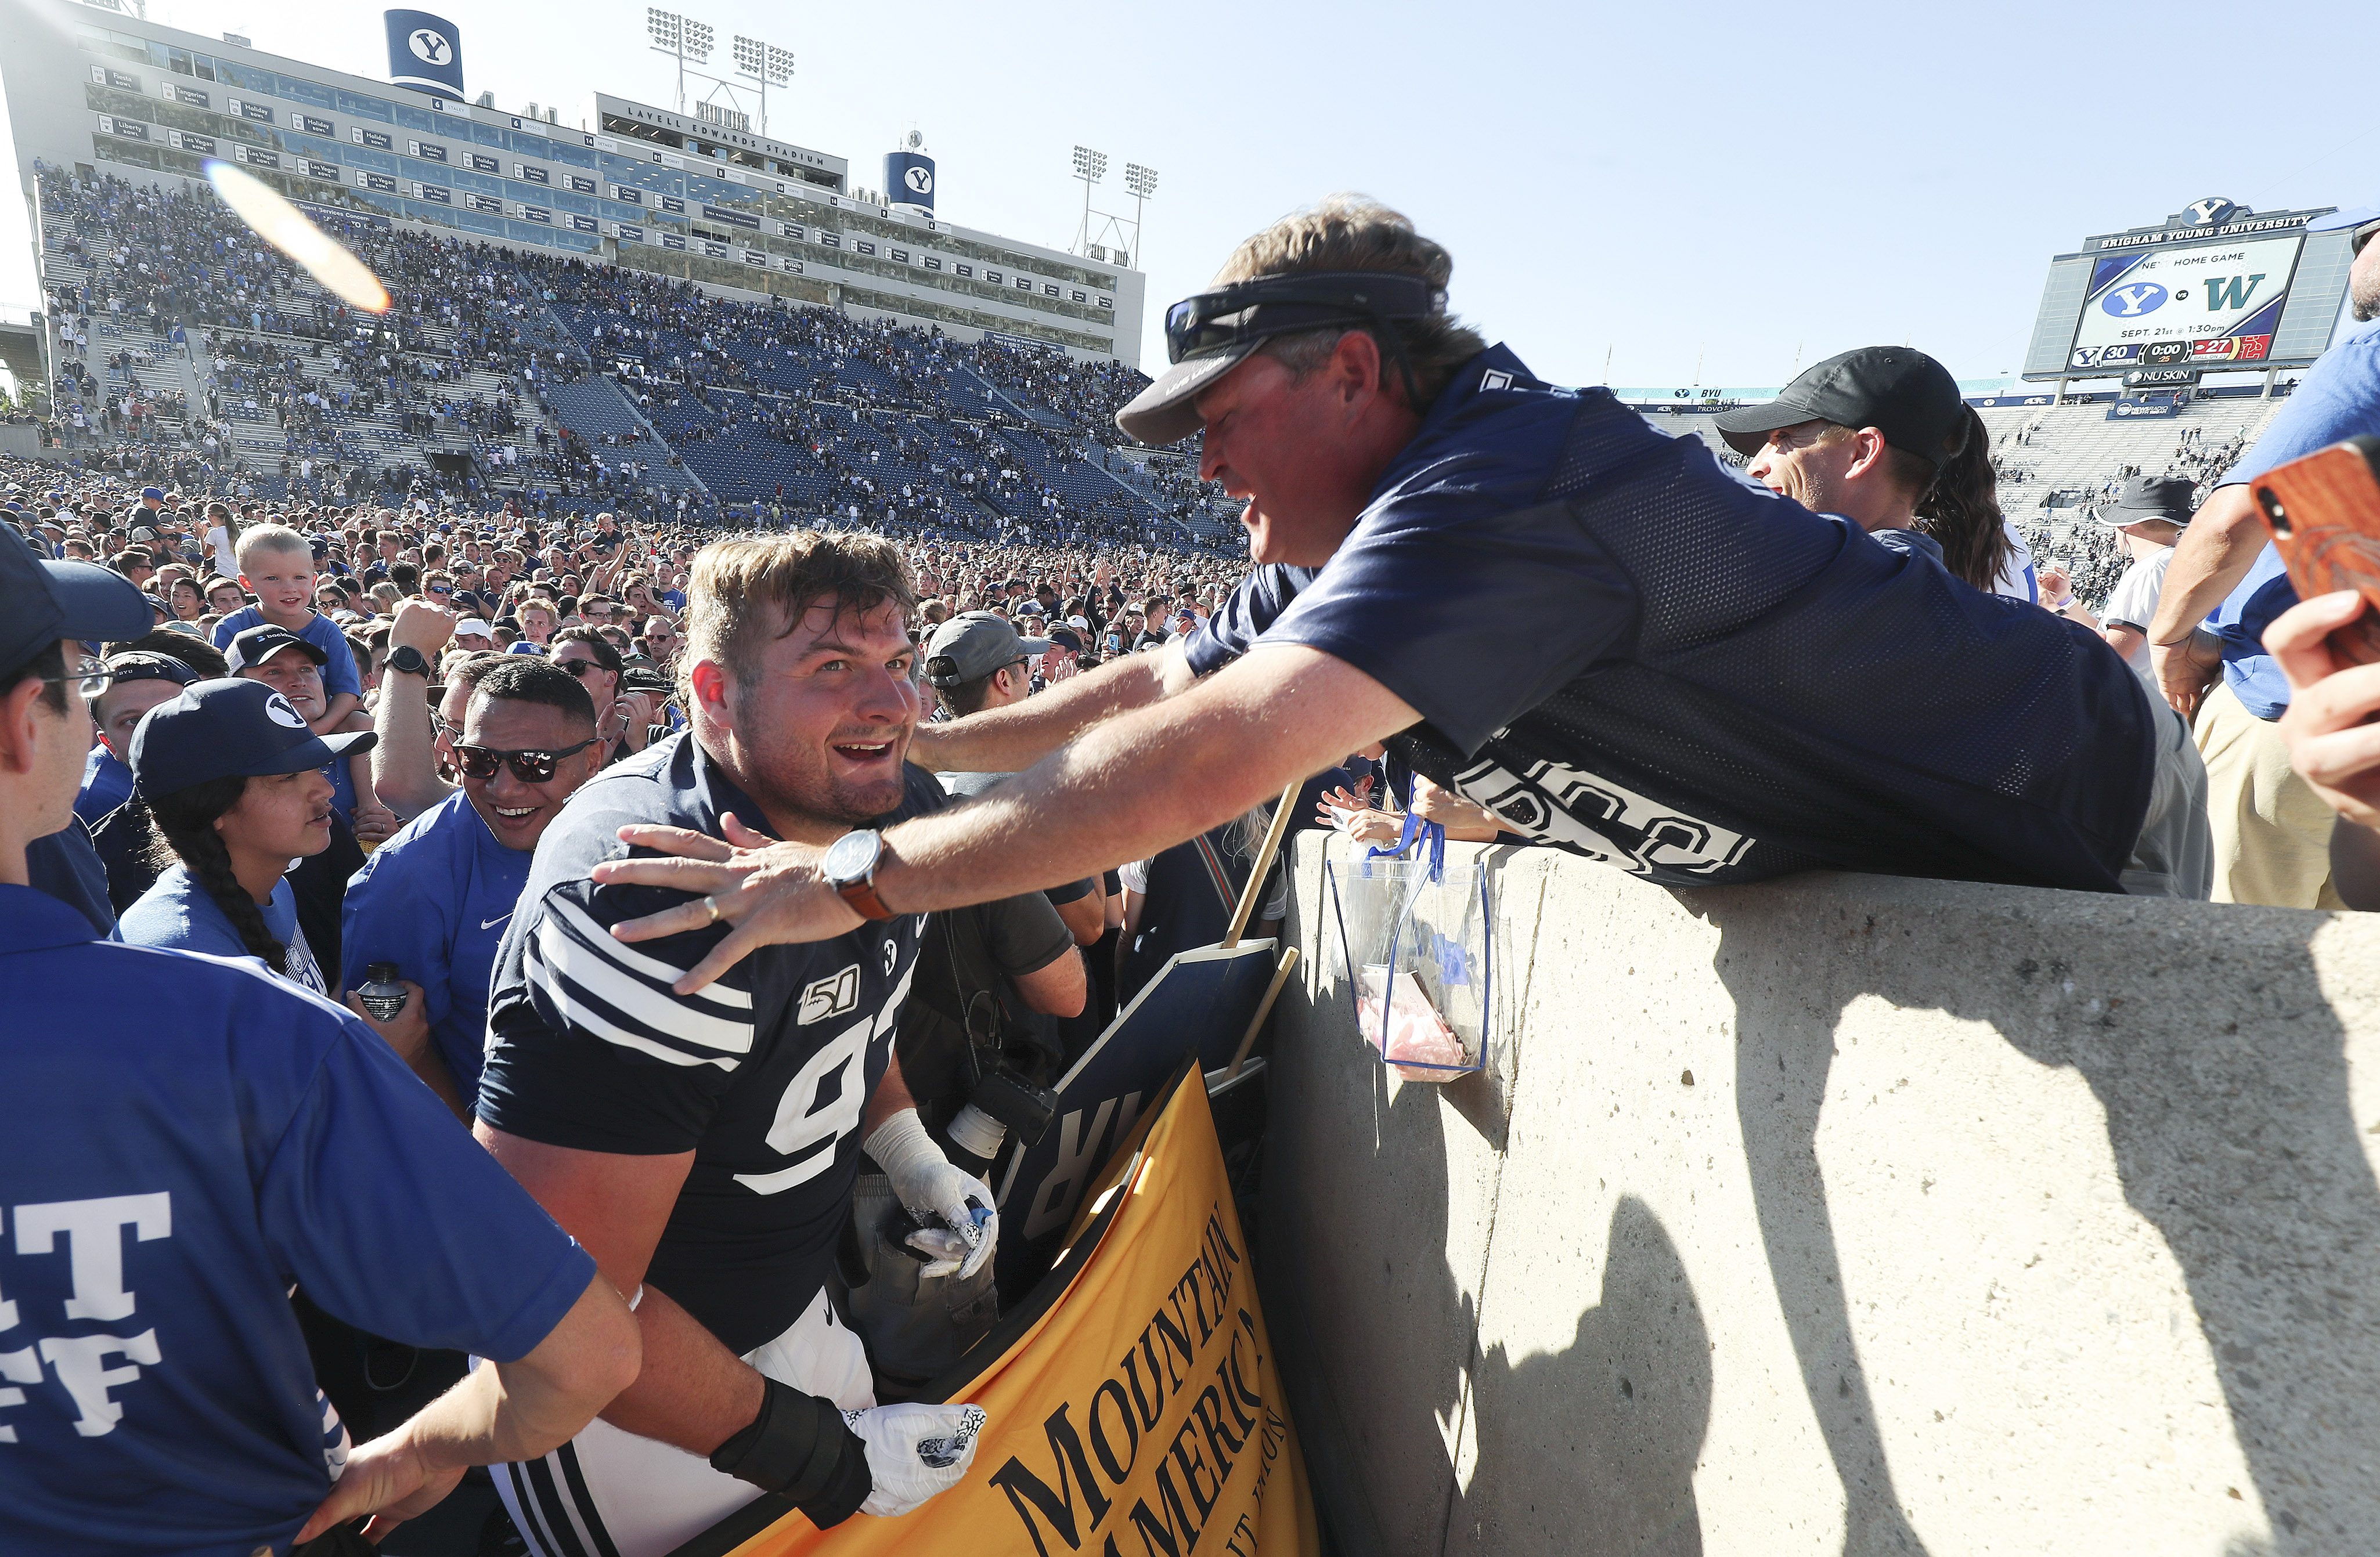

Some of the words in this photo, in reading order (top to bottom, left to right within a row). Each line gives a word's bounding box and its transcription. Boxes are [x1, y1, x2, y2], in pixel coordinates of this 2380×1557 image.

[113, 72, 132, 82] Fiesta
[176, 87, 206, 100] Tangerine
[245, 104, 268, 115] Holiday
[118, 121, 142, 132] Liberty
[308, 118, 329, 129] Holiday
[183, 135, 194, 143] Las
[194, 138, 213, 147] Vegas
[366, 132, 387, 142] Holiday
[628, 107, 681, 128] LAVELL
[693, 124, 756, 147] EDWARDS
[766, 144, 824, 165] STADIUM
[423, 144, 442, 154] Holiday
[259, 152, 276, 161] Vegas
[475, 157, 495, 167] Holiday
[320, 165, 337, 174] Vegas
[527, 168, 544, 177] Holiday
[378, 177, 394, 186] Vegas
[575, 178, 592, 187] Holiday
[433, 189, 448, 197] Vegas
[665, 198, 683, 207] Freedom
[319, 208, 344, 216] Services
[2189, 198, 2227, 224] Y
[735, 217, 758, 225] CHAMPIONS
[2100, 233, 2162, 248] BRIGHAM
[2167, 227, 2214, 242] YOUNG
[2219, 215, 2313, 235] UNIVERSITY
[859, 243, 872, 251] Holiday
[893, 250, 906, 258] Holiday
[926, 258, 939, 266] Holiday
[2174, 257, 2207, 267] HOME
[2211, 252, 2245, 263] GAME
[2203, 273, 2266, 312] W
[2121, 328, 2151, 338] SEPT.
[2188, 324, 2225, 334] 1:30pm
[2151, 344, 2181, 356] 0:00
[2205, 340, 2230, 353] 27
[2106, 346, 2127, 359] 30
[2143, 372, 2163, 381] NU
[2163, 370, 2189, 380] SKIN
[1701, 389, 1722, 398] BYU
[989, 1201, 1241, 1557] MOUNTAIN
